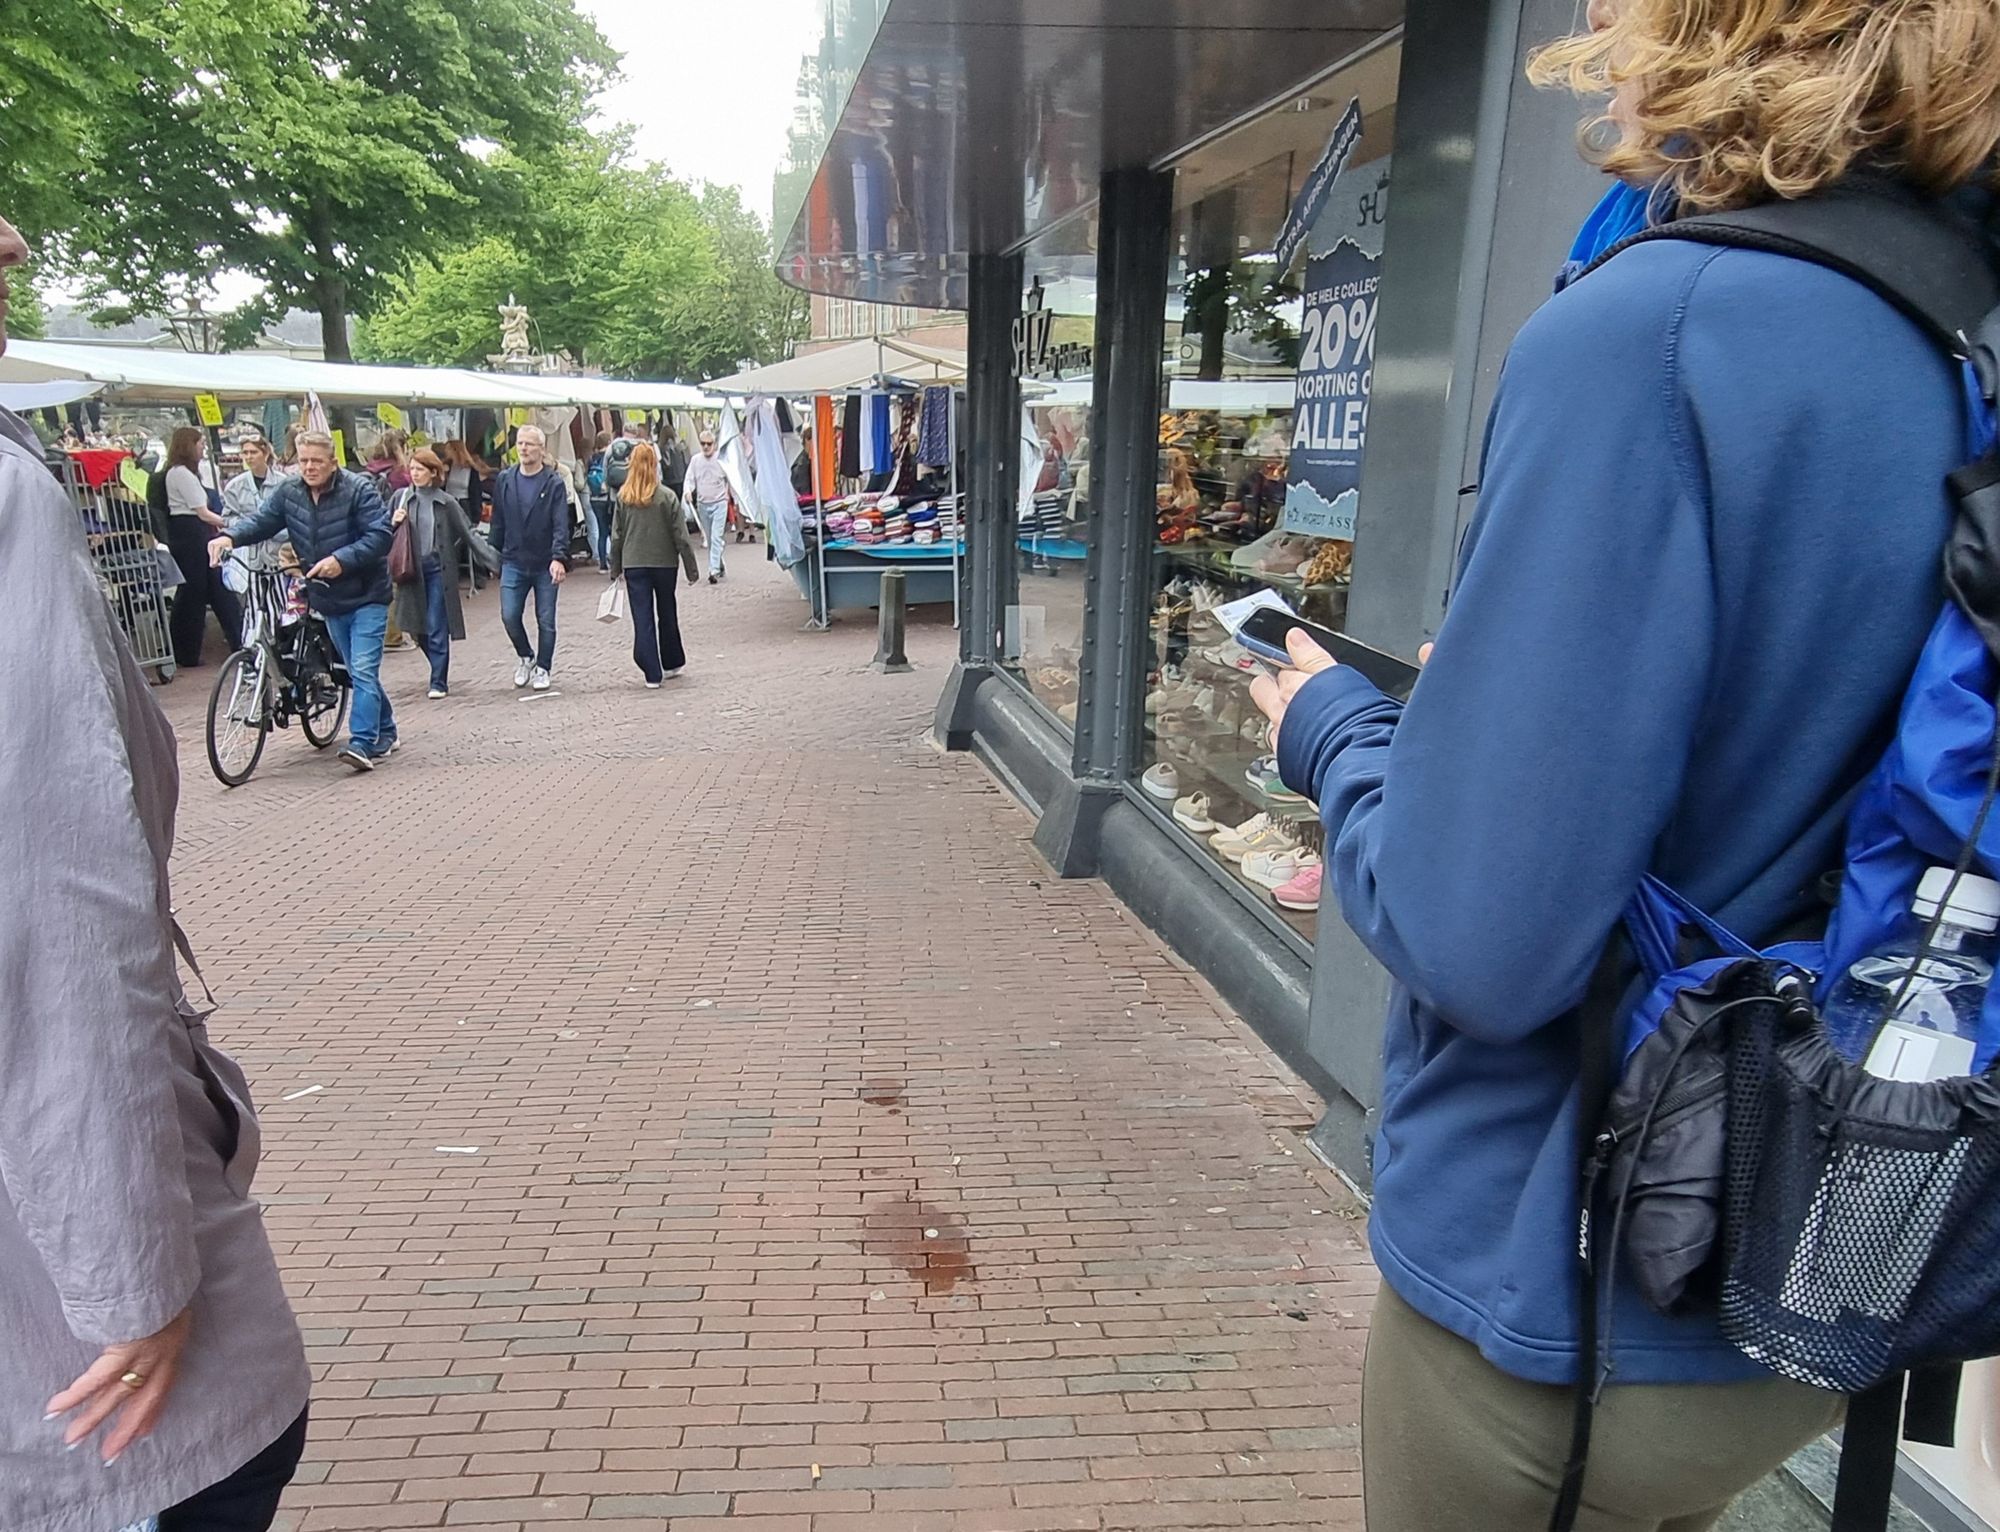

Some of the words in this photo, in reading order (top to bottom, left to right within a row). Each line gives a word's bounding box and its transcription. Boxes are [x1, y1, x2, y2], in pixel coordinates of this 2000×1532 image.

[1279, 218, 1303, 262] EXTRA
[1306, 291, 1318, 307] DE
[1318, 287, 1340, 305] HELE
[1341, 276, 1380, 299] COLLEC
[1299, 296, 1379, 372] 20%
[1296, 371, 1357, 399] KORTING
[1578, 1208, 1589, 1260] OMM
